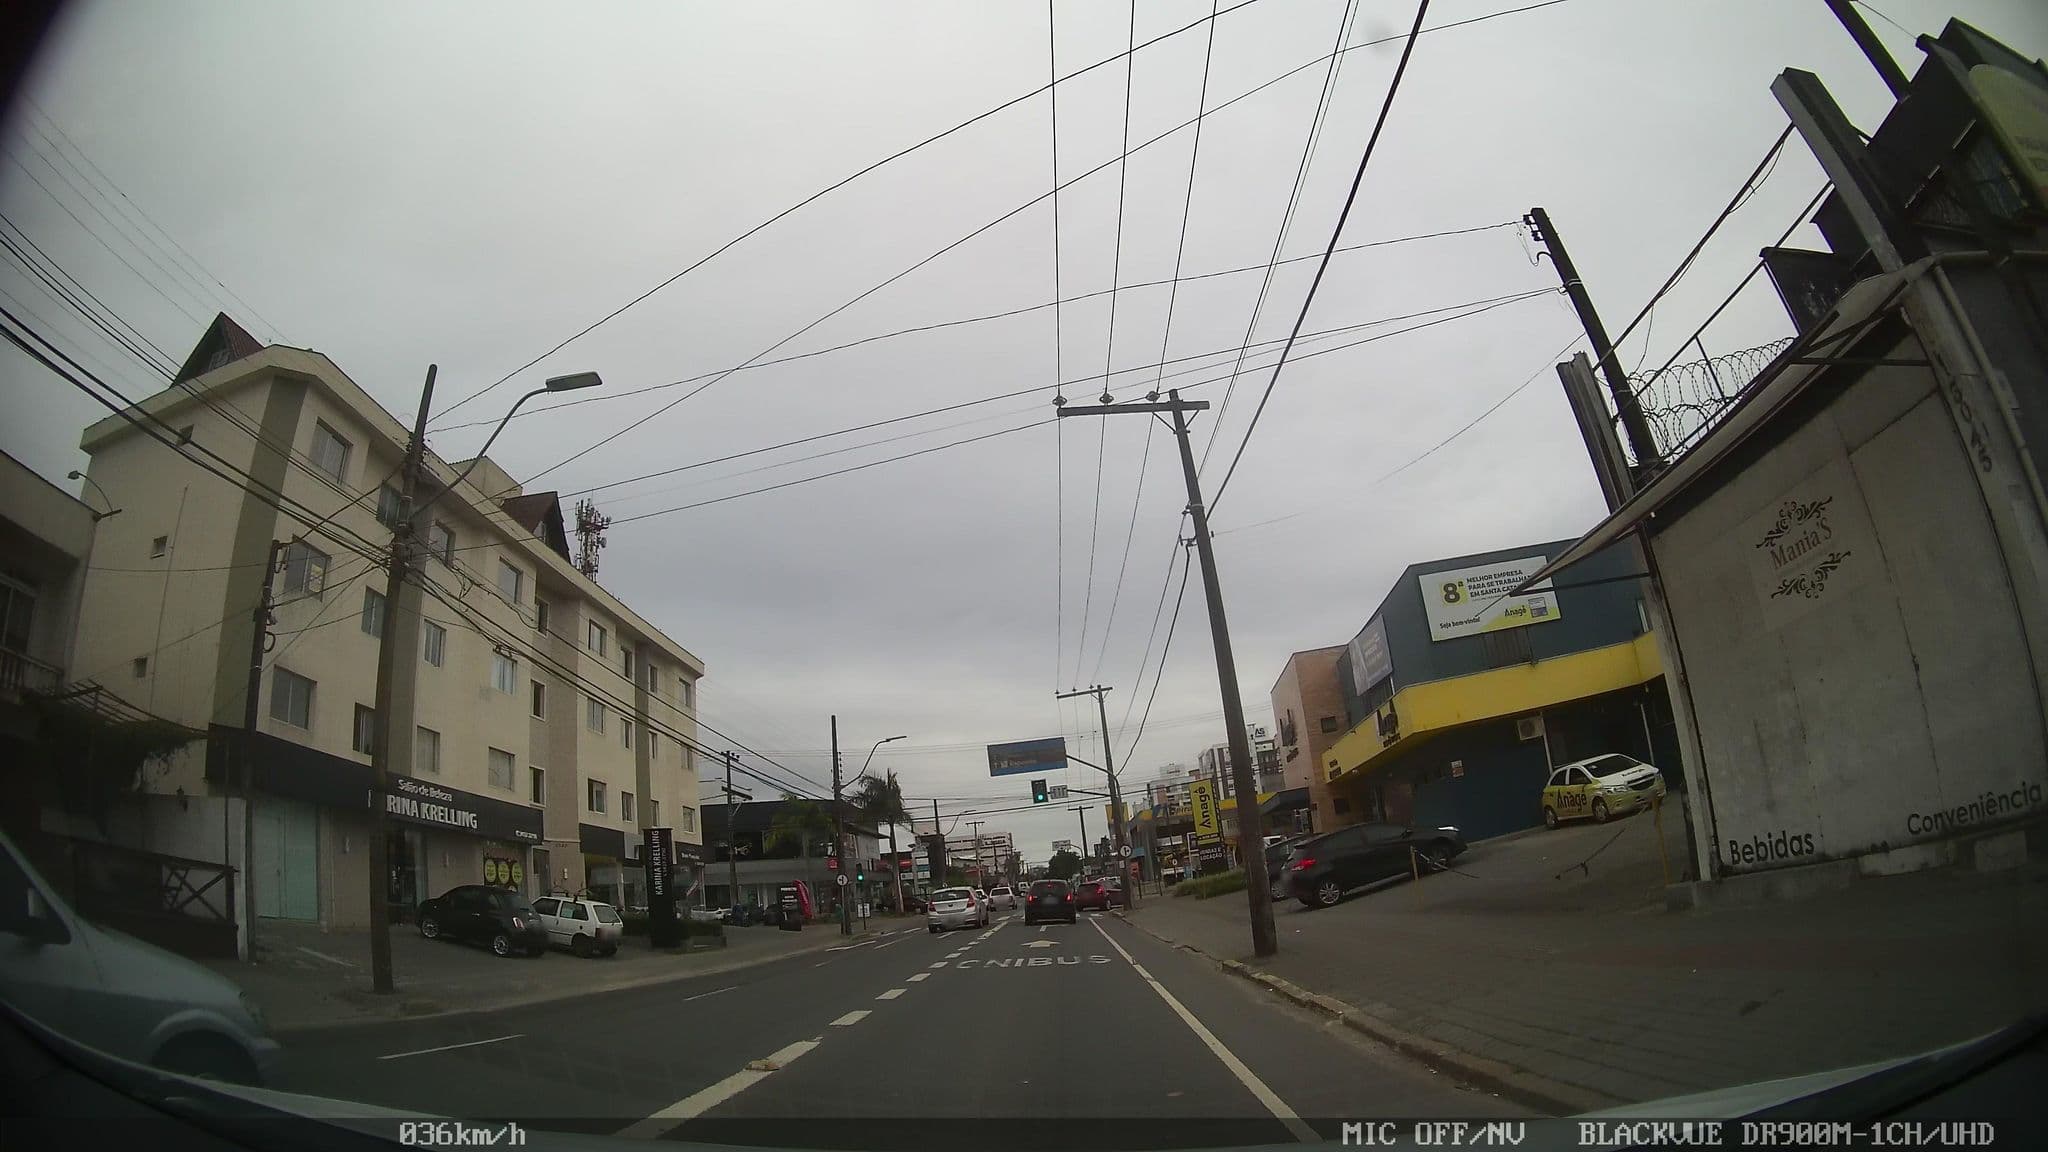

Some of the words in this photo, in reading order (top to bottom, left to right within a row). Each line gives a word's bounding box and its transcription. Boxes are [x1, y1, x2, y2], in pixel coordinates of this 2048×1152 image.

[1466, 573, 1494, 583] MELHOR
[1493, 569, 1523, 579] EMPRESA
[1468, 582, 1487, 591] PARA
[1486, 580, 1495, 589] SE
[1469, 590, 1480, 598] EM
[1480, 587, 1502, 597] SANTA
[418, 784, 430, 796] de
[420, 801, 478, 829] KRELLING
[1729, 830, 1816, 866] Bebidas
[1907, 780, 2042, 835] Conveniência
[651, 829, 662, 866] KRELLING
[653, 866, 664, 896] KARINA
